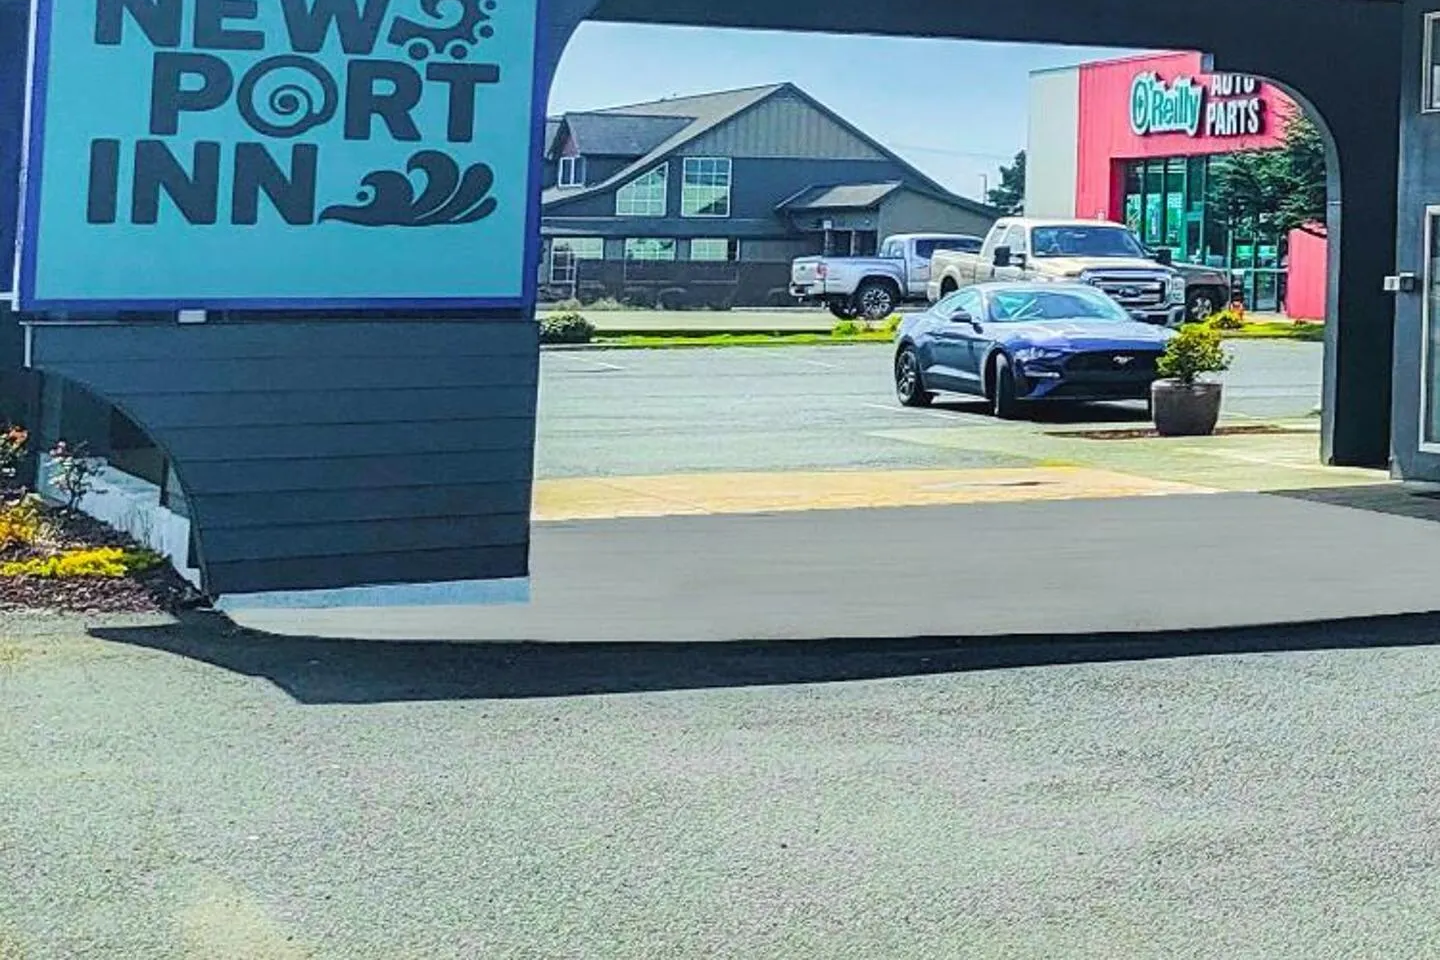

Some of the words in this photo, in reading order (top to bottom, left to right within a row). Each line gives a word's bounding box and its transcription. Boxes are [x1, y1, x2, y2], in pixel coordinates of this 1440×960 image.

[149, 51, 500, 142] PORT
[1131, 72, 1202, 136] O'Reilly
[1205, 98, 1260, 136] PARTS
[87, 138, 318, 225] INN
